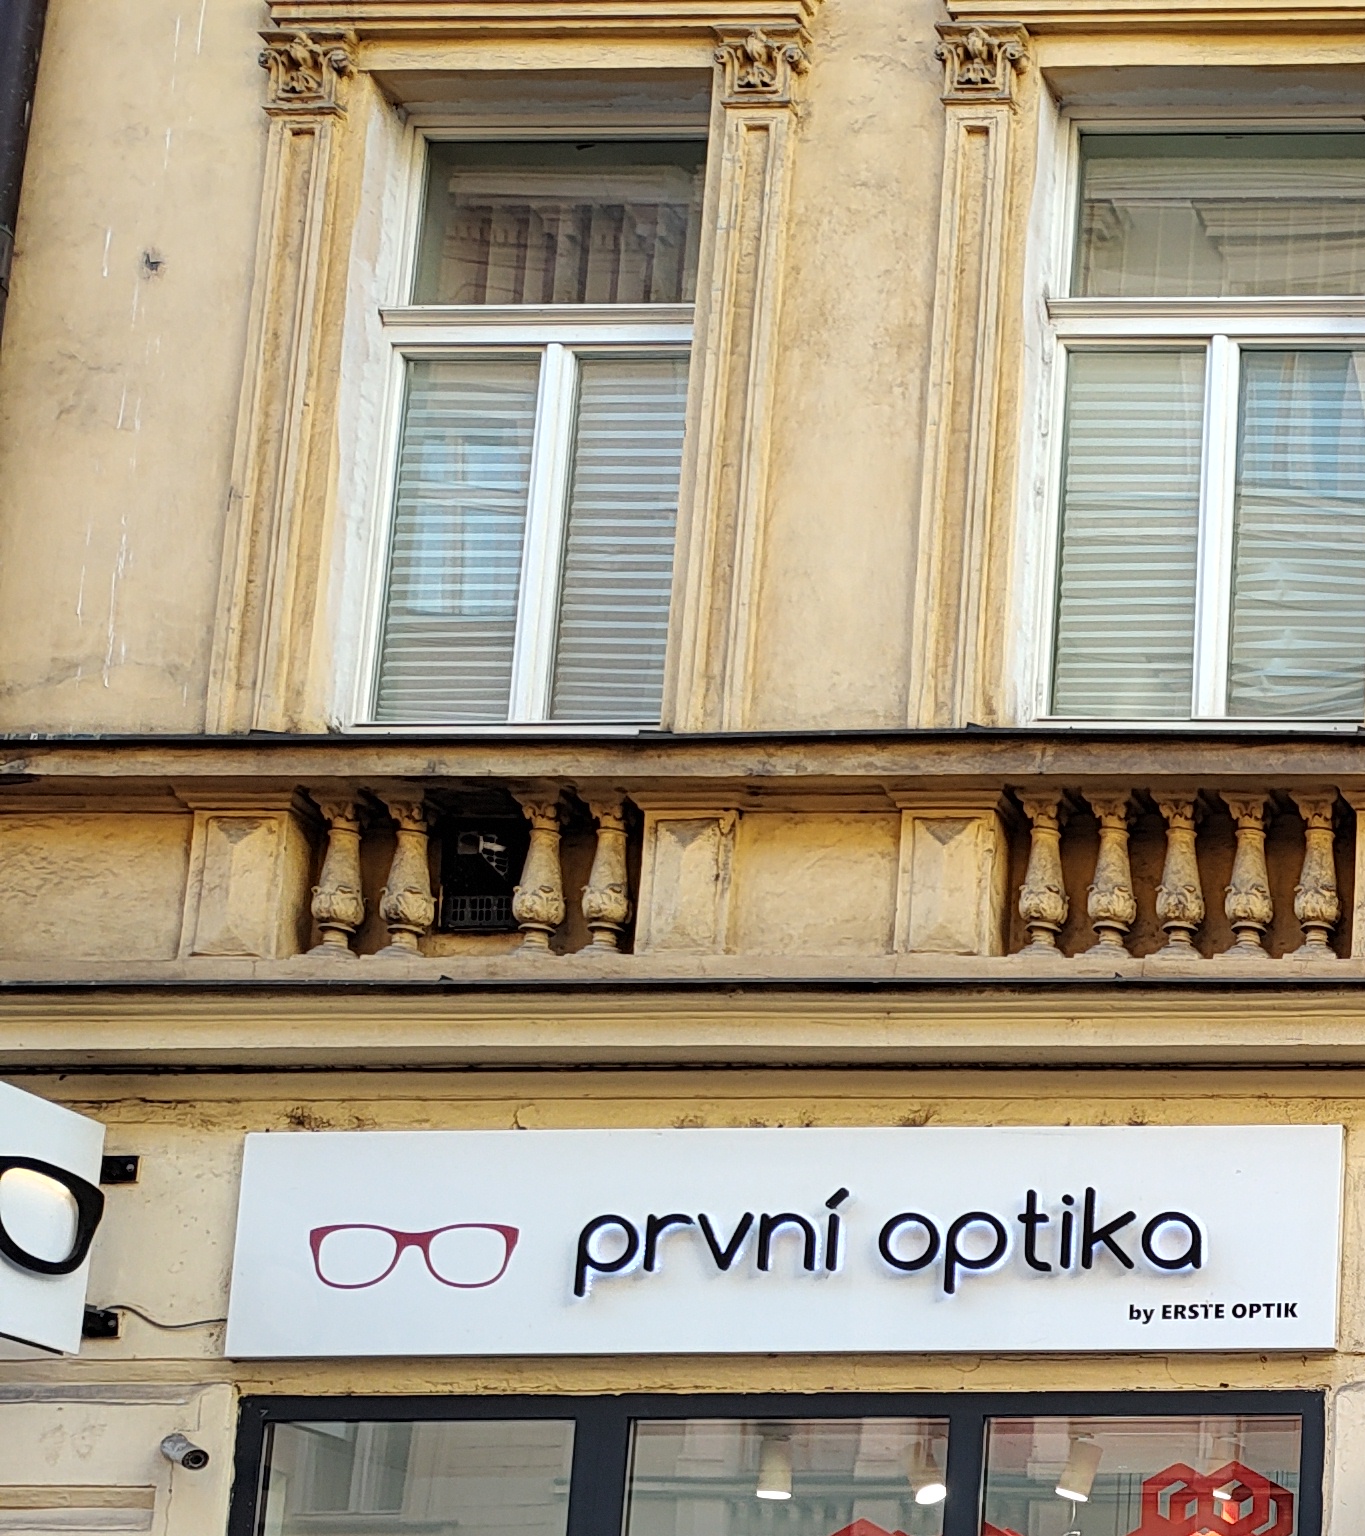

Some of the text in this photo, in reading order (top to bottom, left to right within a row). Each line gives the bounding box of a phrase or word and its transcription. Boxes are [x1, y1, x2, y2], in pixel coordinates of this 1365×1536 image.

[573, 1187, 1204, 1297] první optika
[1128, 1301, 1298, 1323] by ERSTE OPTIK
